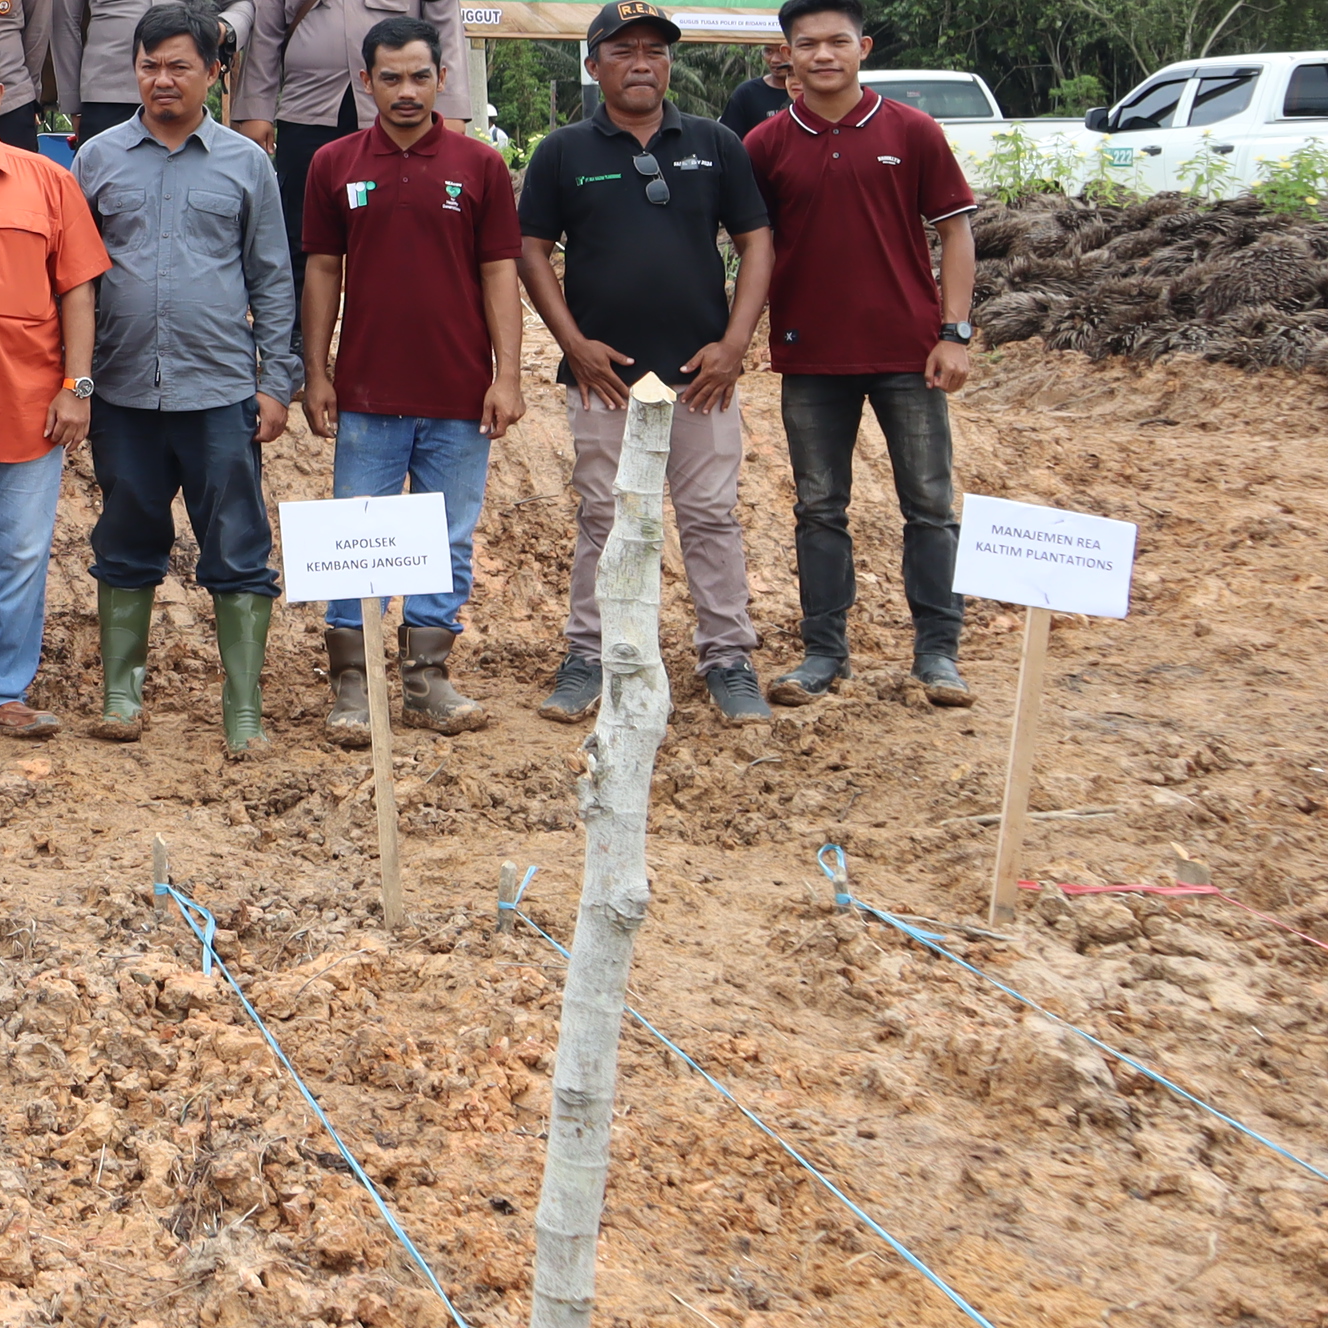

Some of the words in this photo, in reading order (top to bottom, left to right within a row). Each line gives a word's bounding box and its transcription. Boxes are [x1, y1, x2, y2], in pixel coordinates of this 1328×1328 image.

[1113, 149, 1132, 164] 222
[335, 536, 396, 550] KAPOLSEK
[991, 524, 1073, 546] MANAJEMEN
[1076, 537, 1102, 550] REA
[306, 558, 369, 572] KEMBANG
[371, 555, 428, 569] JANGGUT
[975, 541, 1022, 557] KALTIM
[1025, 548, 1113, 571] PLANTATIONS
